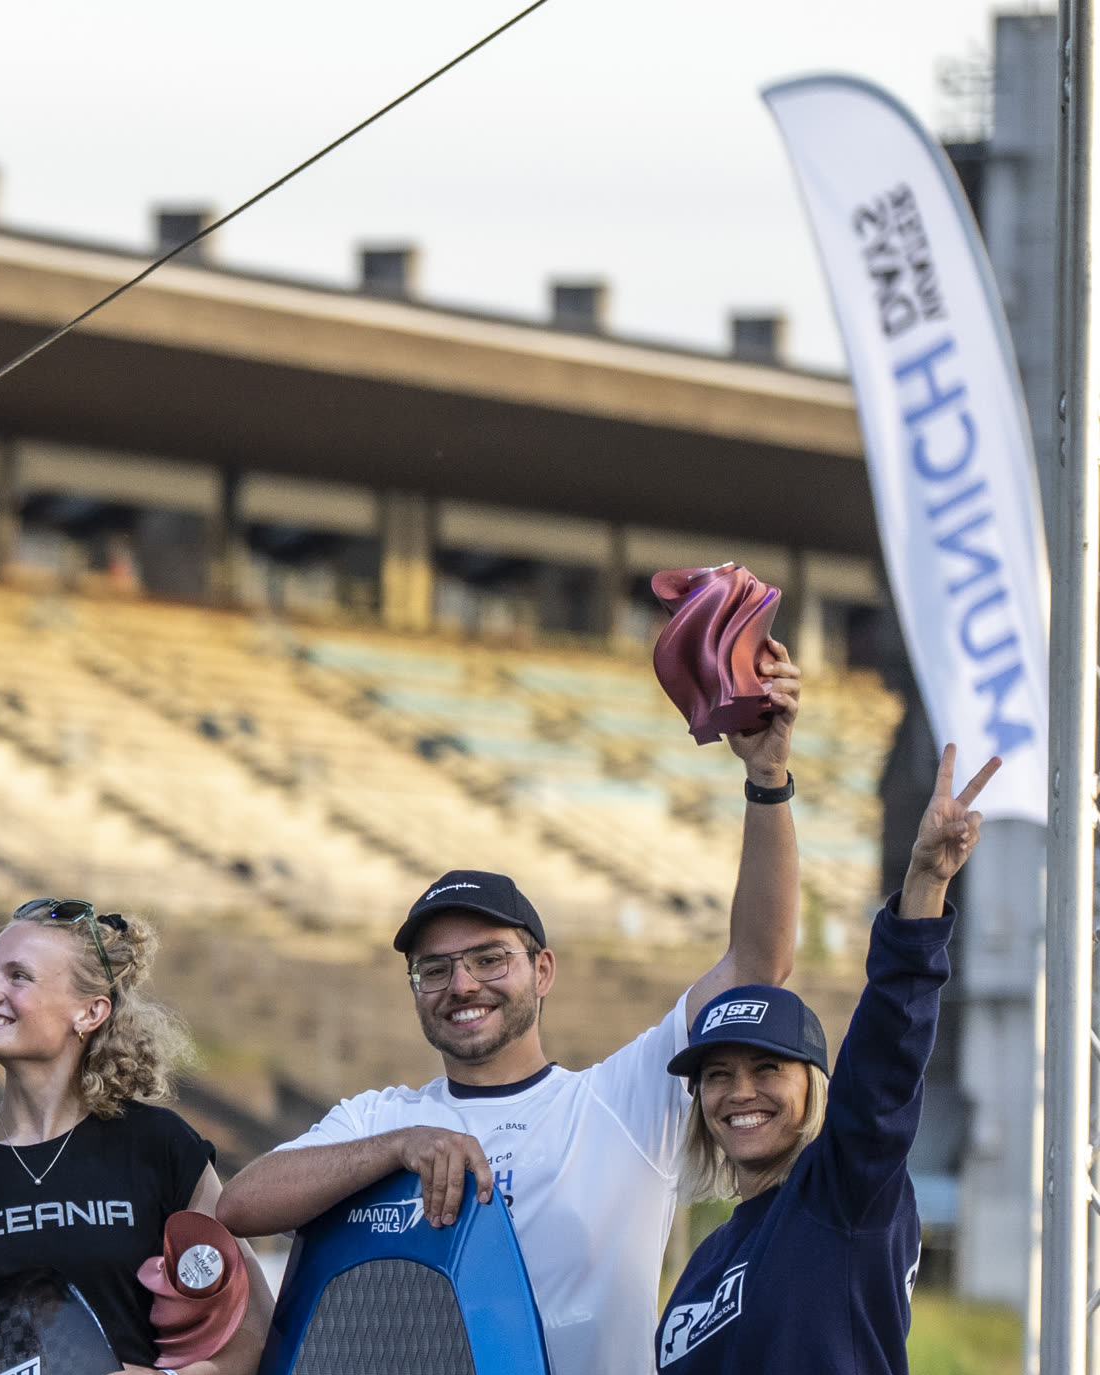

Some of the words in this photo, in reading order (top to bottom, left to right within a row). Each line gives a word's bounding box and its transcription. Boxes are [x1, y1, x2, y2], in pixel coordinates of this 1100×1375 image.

[426, 882, 481, 900] Champion
[727, 1004, 764, 1016] SFT
[505, 1123, 528, 1131] BASE
[347, 1208, 400, 1223] MANTA
[371, 1223, 400, 1233] FOILS
